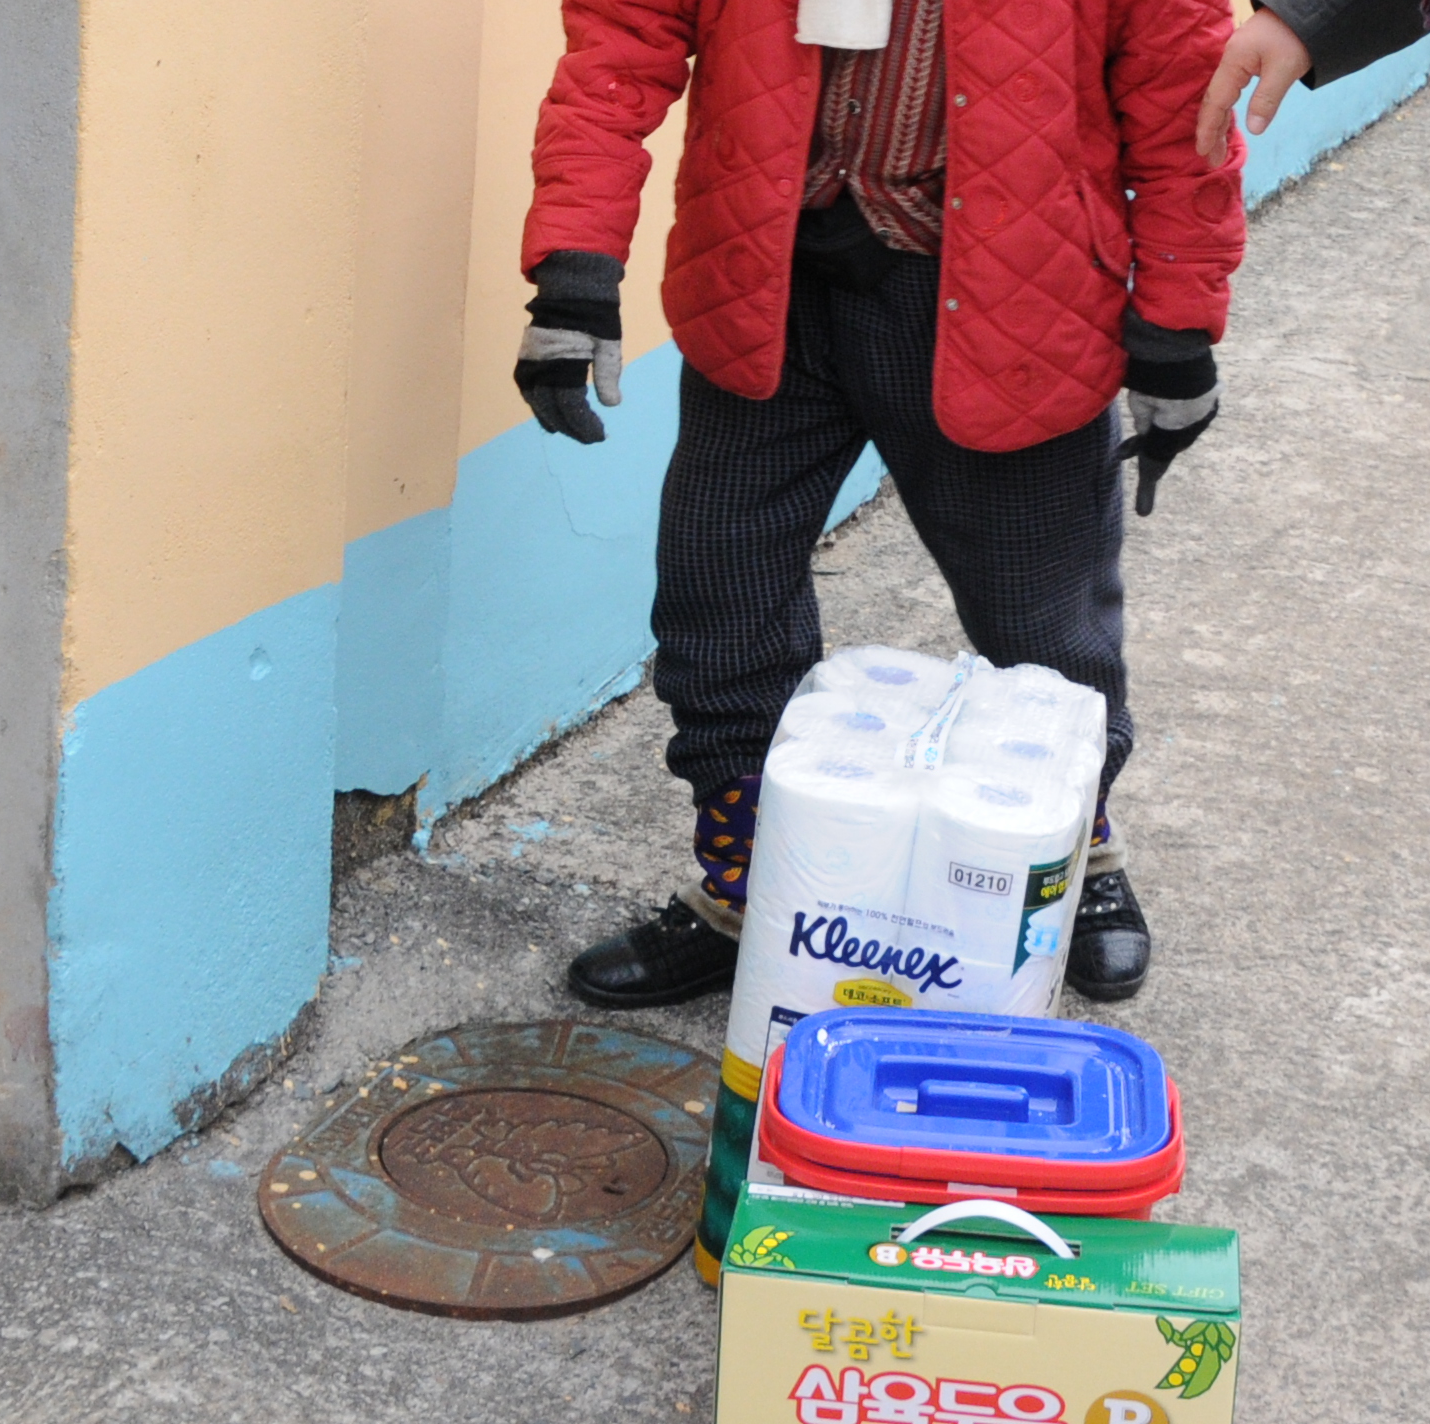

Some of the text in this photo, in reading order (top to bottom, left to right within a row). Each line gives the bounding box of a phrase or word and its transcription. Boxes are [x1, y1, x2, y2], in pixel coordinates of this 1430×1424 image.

[954, 868, 1008, 893] 01210
[866, 908, 889, 922] 100%
[789, 911, 963, 993] Kleenex
[875, 1244, 900, 1265] B
[910, 1245, 1041, 1280] 삼육두유
[1125, 1280, 1225, 1300] GIFT SET
[797, 1308, 923, 1361] 달콤한
